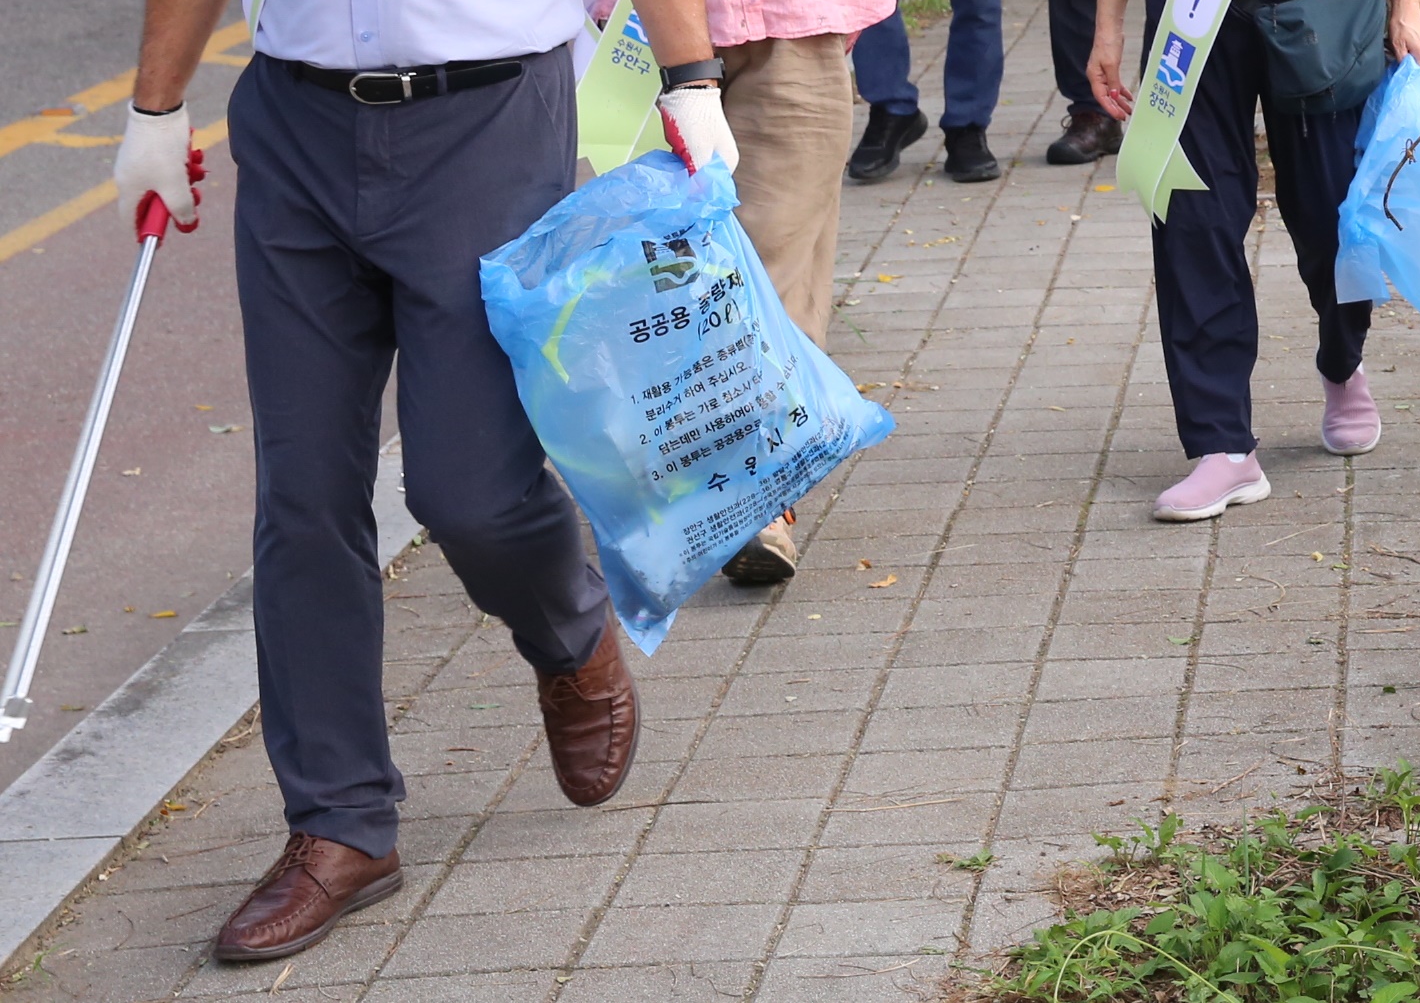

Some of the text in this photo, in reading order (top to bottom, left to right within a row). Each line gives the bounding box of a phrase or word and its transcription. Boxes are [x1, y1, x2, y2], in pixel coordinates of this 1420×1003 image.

[611, 46, 651, 75] 장안구
[617, 38, 643, 56] 수원시
[1149, 89, 1176, 118] 장안구
[628, 305, 691, 344] 공공용
[642, 380, 672, 401] 재활용
[674, 354, 714, 387] 가능품은
[645, 360, 752, 422] 분리수거 하여 주십시오.
[653, 425, 663, 438] 이
[664, 409, 697, 432] 봉투는
[697, 396, 721, 415] 가로
[658, 402, 755, 456] 담는데만 사용하여야
[666, 460, 679, 473] 이
[680, 446, 713, 469] 봉투는
[682, 519, 705, 536] 장안구
